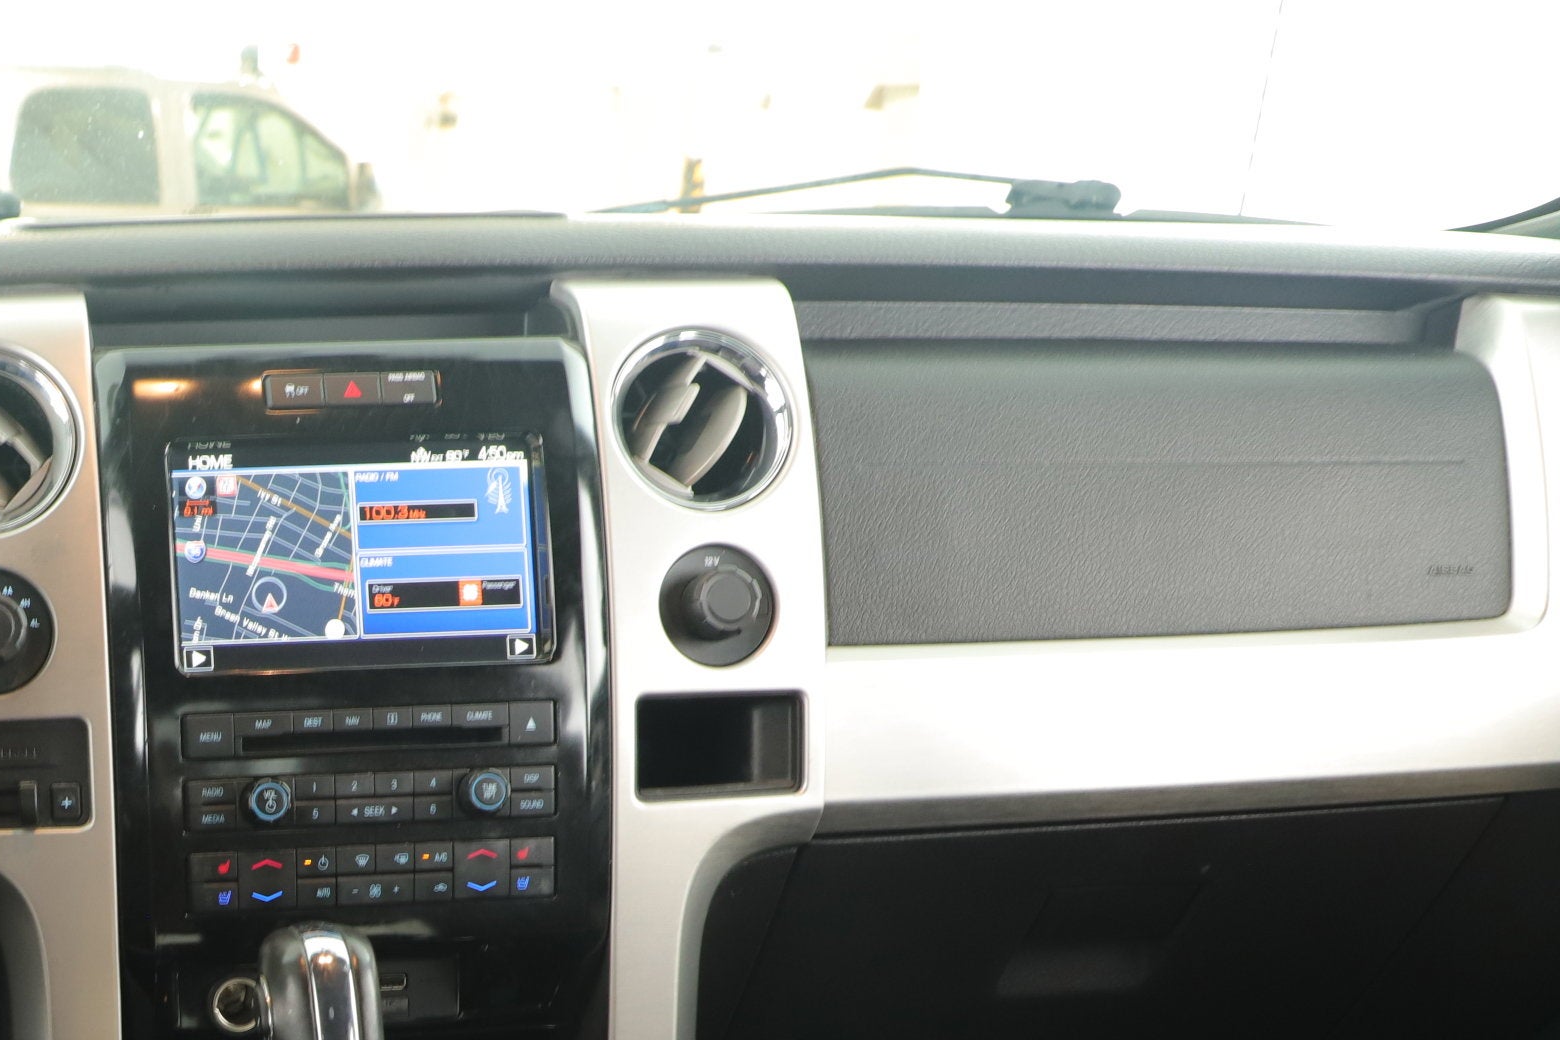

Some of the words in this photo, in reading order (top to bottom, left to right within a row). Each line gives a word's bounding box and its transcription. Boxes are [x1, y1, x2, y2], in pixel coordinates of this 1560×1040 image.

[188, 454, 233, 470] HOME
[385, 471, 399, 482] FM
[363, 504, 409, 521] 100.3
[303, 716, 323, 728] DEST
[345, 715, 361, 727] NAV
[420, 711, 443, 722] PHONE
[466, 710, 493, 722] CLIMATE
[254, 719, 273, 730] MAP
[199, 731, 222, 743] MENU
[351, 780, 358, 792] 2
[390, 778, 398, 791] 3
[429, 777, 437, 788] 4
[201, 786, 224, 798] RADIO
[520, 799, 544, 809] SOUND
[312, 808, 319, 820] 5
[363, 805, 385, 817] SEEK
[201, 813, 225, 825] MEDIA
[434, 852, 448, 863] A/C
